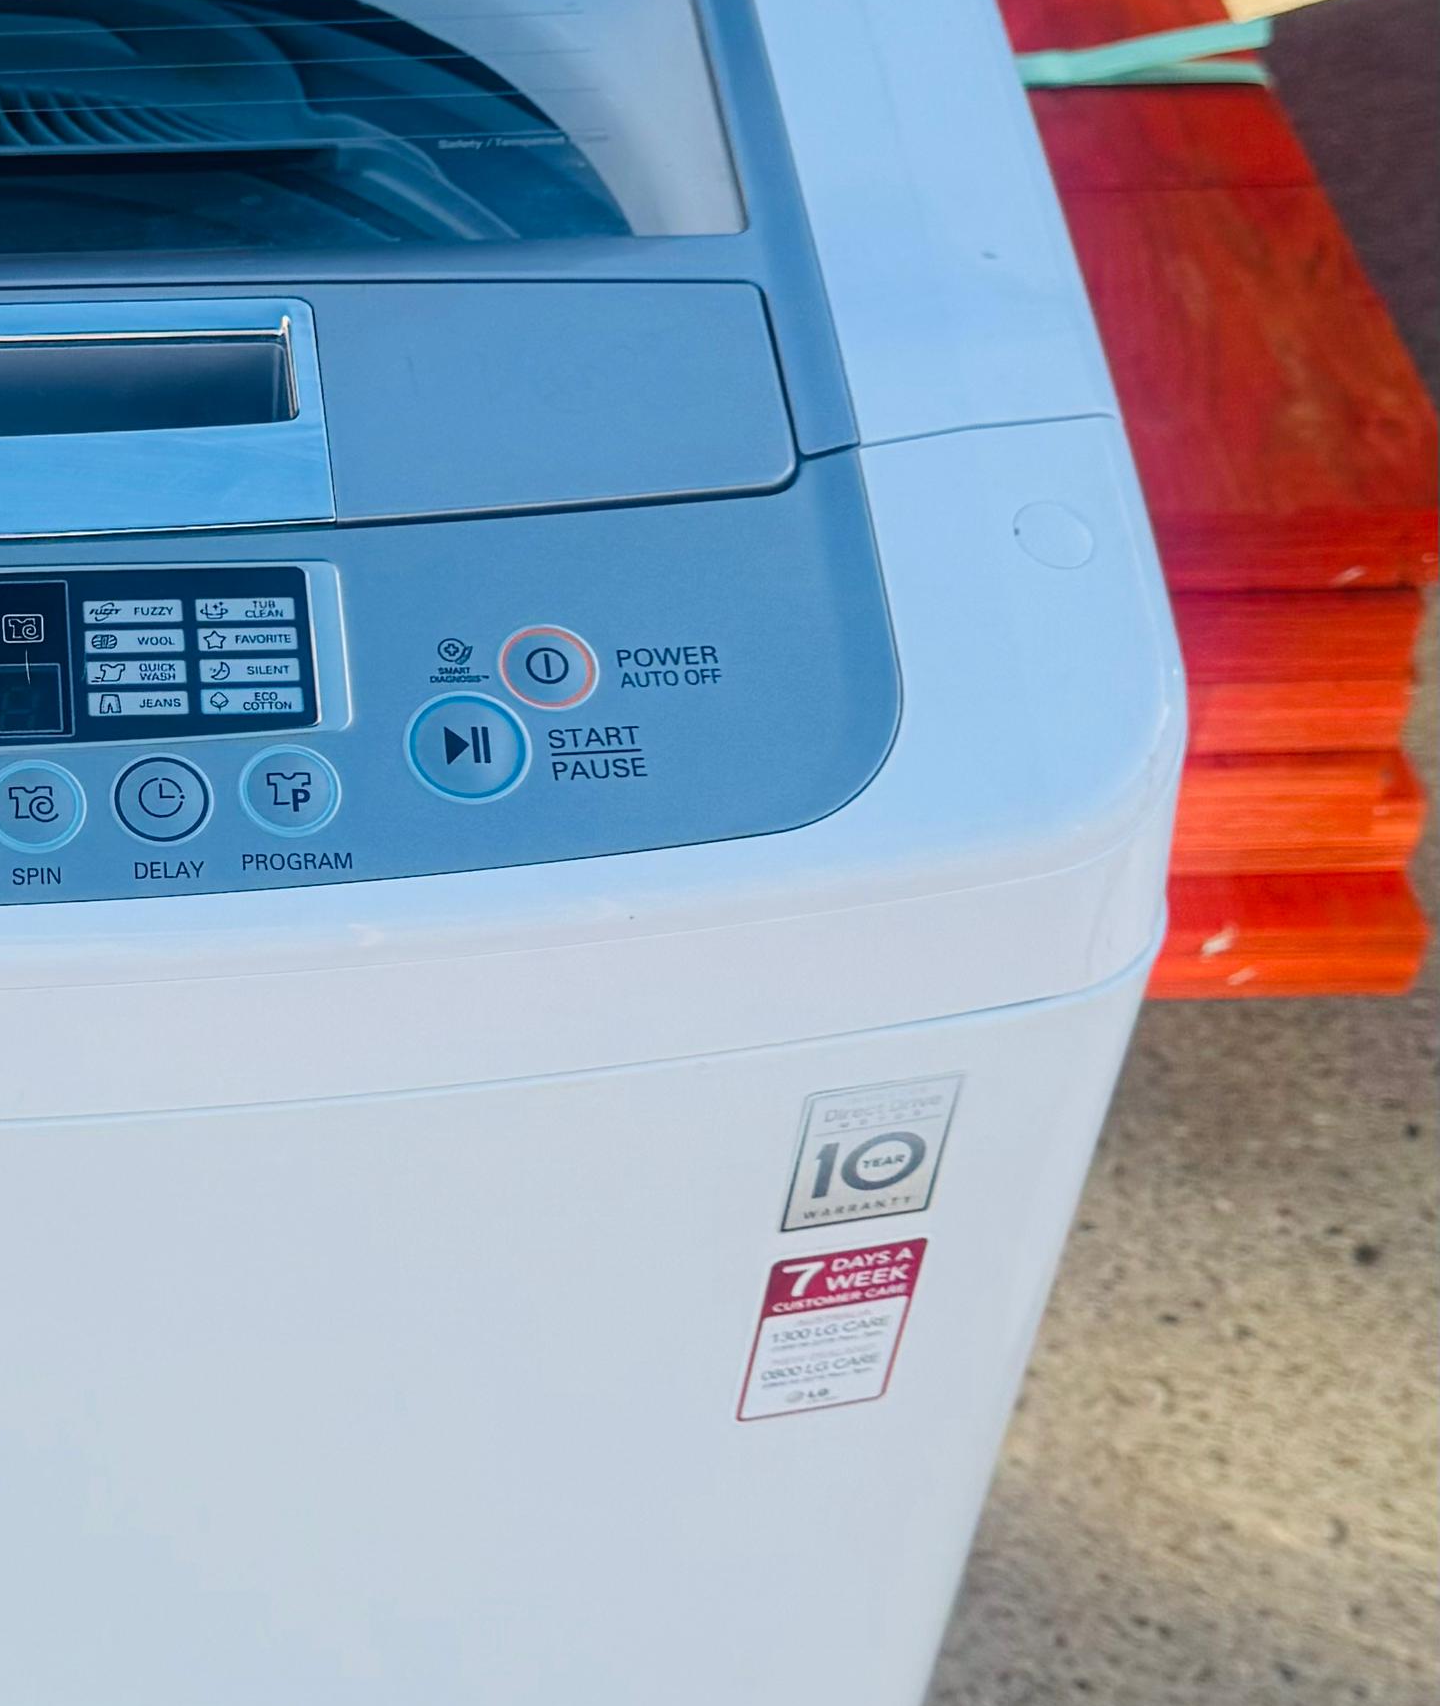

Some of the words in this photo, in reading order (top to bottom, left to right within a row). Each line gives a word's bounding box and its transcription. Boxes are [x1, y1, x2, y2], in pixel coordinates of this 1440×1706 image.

[133, 606, 173, 617] FUZZY
[252, 600, 276, 609] TUB
[245, 609, 284, 618] CLEAN
[137, 636, 176, 646] WOOL
[234, 634, 292, 644] FAVORITE
[616, 645, 719, 668] POWER
[139, 663, 176, 672] QUICK
[246, 665, 290, 675] SILENT
[139, 672, 176, 681] WASH
[620, 669, 679, 688] AUTO
[684, 668, 723, 684] OFF
[139, 697, 182, 708] JEANS
[254, 691, 278, 701] ECO
[243, 701, 293, 711] COTTON
[548, 726, 640, 748] START
[552, 757, 649, 781] PAUSE
[242, 852, 353, 871] PROGRAM
[12, 868, 61, 886] SPIN
[134, 860, 205, 880] DELAY
[811, 1131, 927, 1199] 10
[863, 1154, 906, 1169] YEAR
[803, 1195, 911, 1220] WARRANTY
[782, 1261, 825, 1297] 7
[831, 1250, 891, 1273] DAYS
[895, 1246, 914, 1262] A
[825, 1264, 911, 1292] WEEK
[772, 1291, 863, 1313] CUSTOMER
[864, 1283, 908, 1299] CARE
